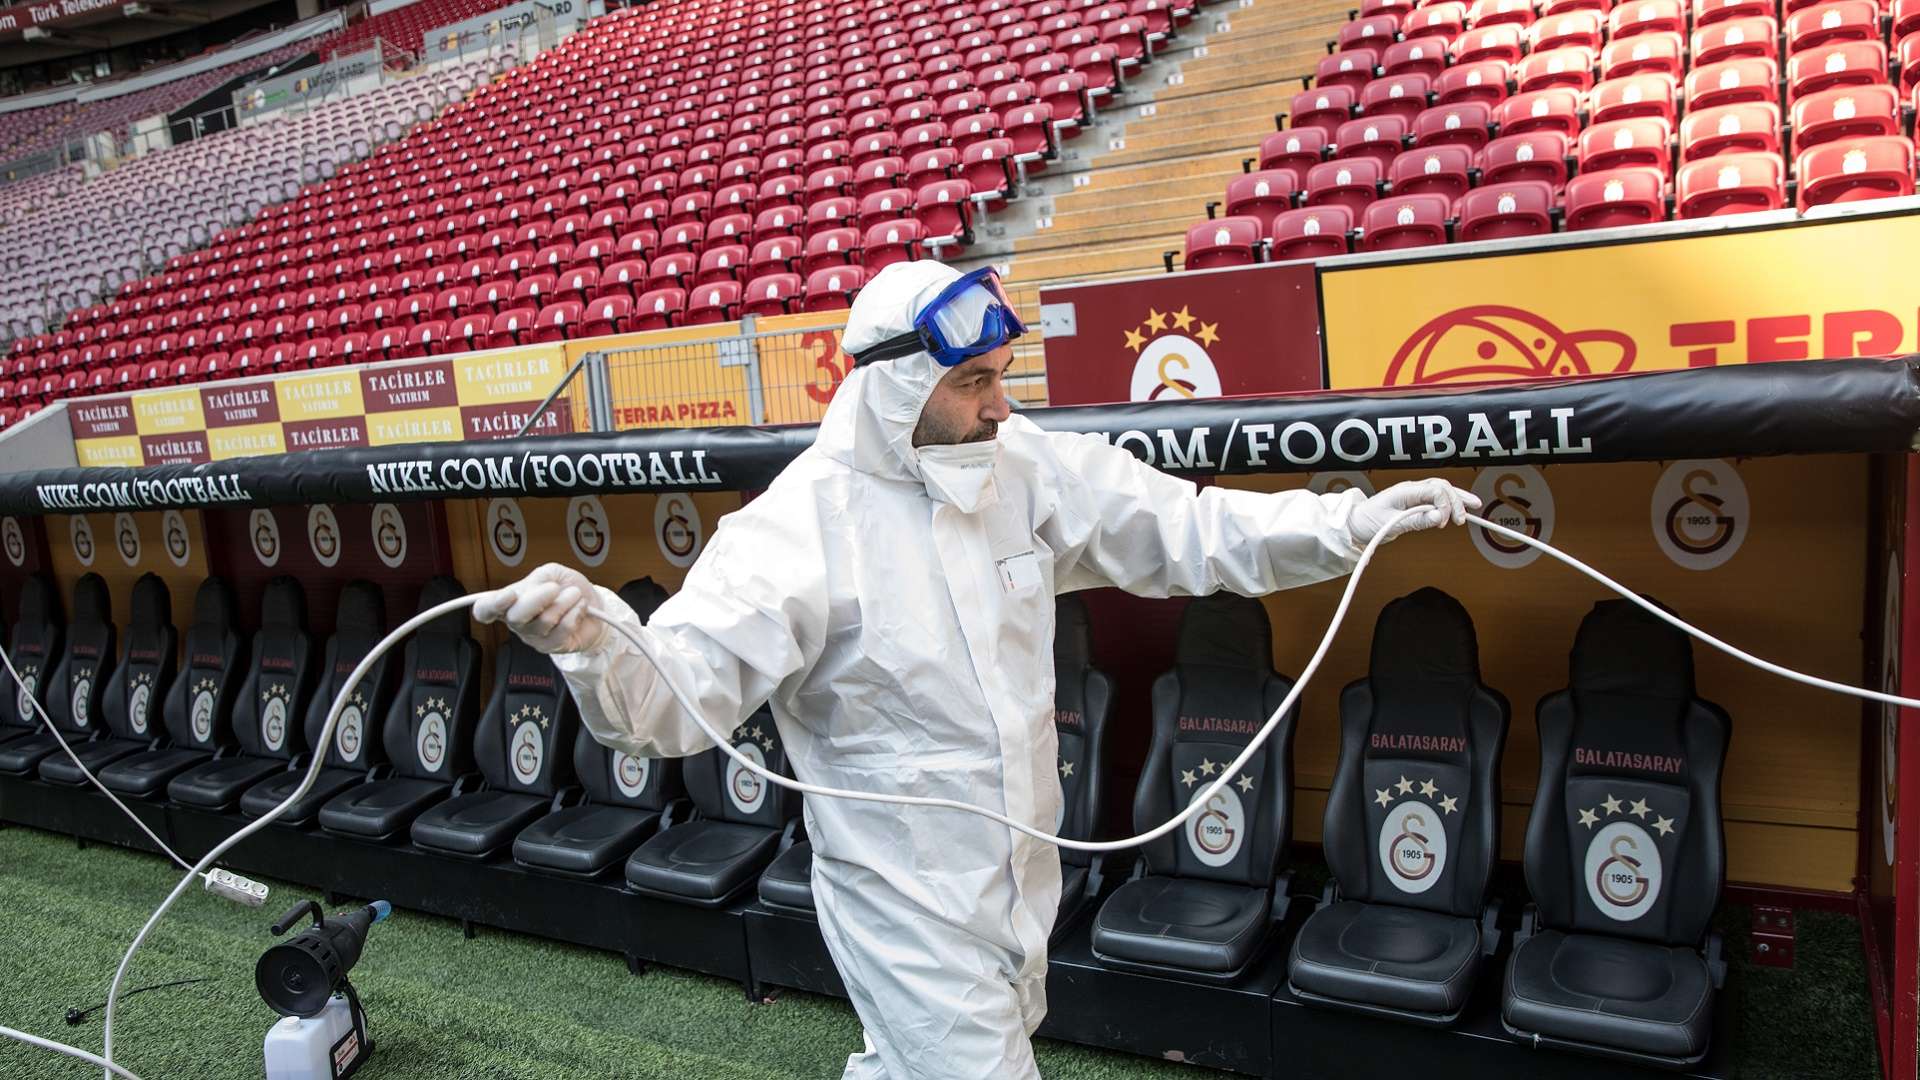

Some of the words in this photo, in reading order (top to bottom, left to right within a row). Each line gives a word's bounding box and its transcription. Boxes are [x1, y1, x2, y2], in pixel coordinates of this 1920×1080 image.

[29, 3, 60, 23] Türk
[1669, 310, 1920, 368] TER
[369, 369, 446, 392] TACİRLER
[207, 388, 270, 410] TACİRLER
[388, 390, 430, 405] YATIRIM
[77, 405, 129, 423] TACİRLER
[290, 427, 360, 447] TACİRLER
[1100, 407, 1592, 471] OM/FOOTBALL
[146, 440, 204, 459] TACİRLER
[367, 450, 722, 492] NIKE.COM/FOOTBALL
[36, 474, 252, 509] NIKE.COM/FOOTBALL
[1687, 515, 1712, 526] 1905
[1371, 733, 1466, 753] GALATASARAY
[1575, 747, 1682, 774] GALATASARAY
[1206, 825, 1222, 835] 1905
[1402, 849, 1421, 859] 1905
[1611, 873, 1633, 885] 1905
